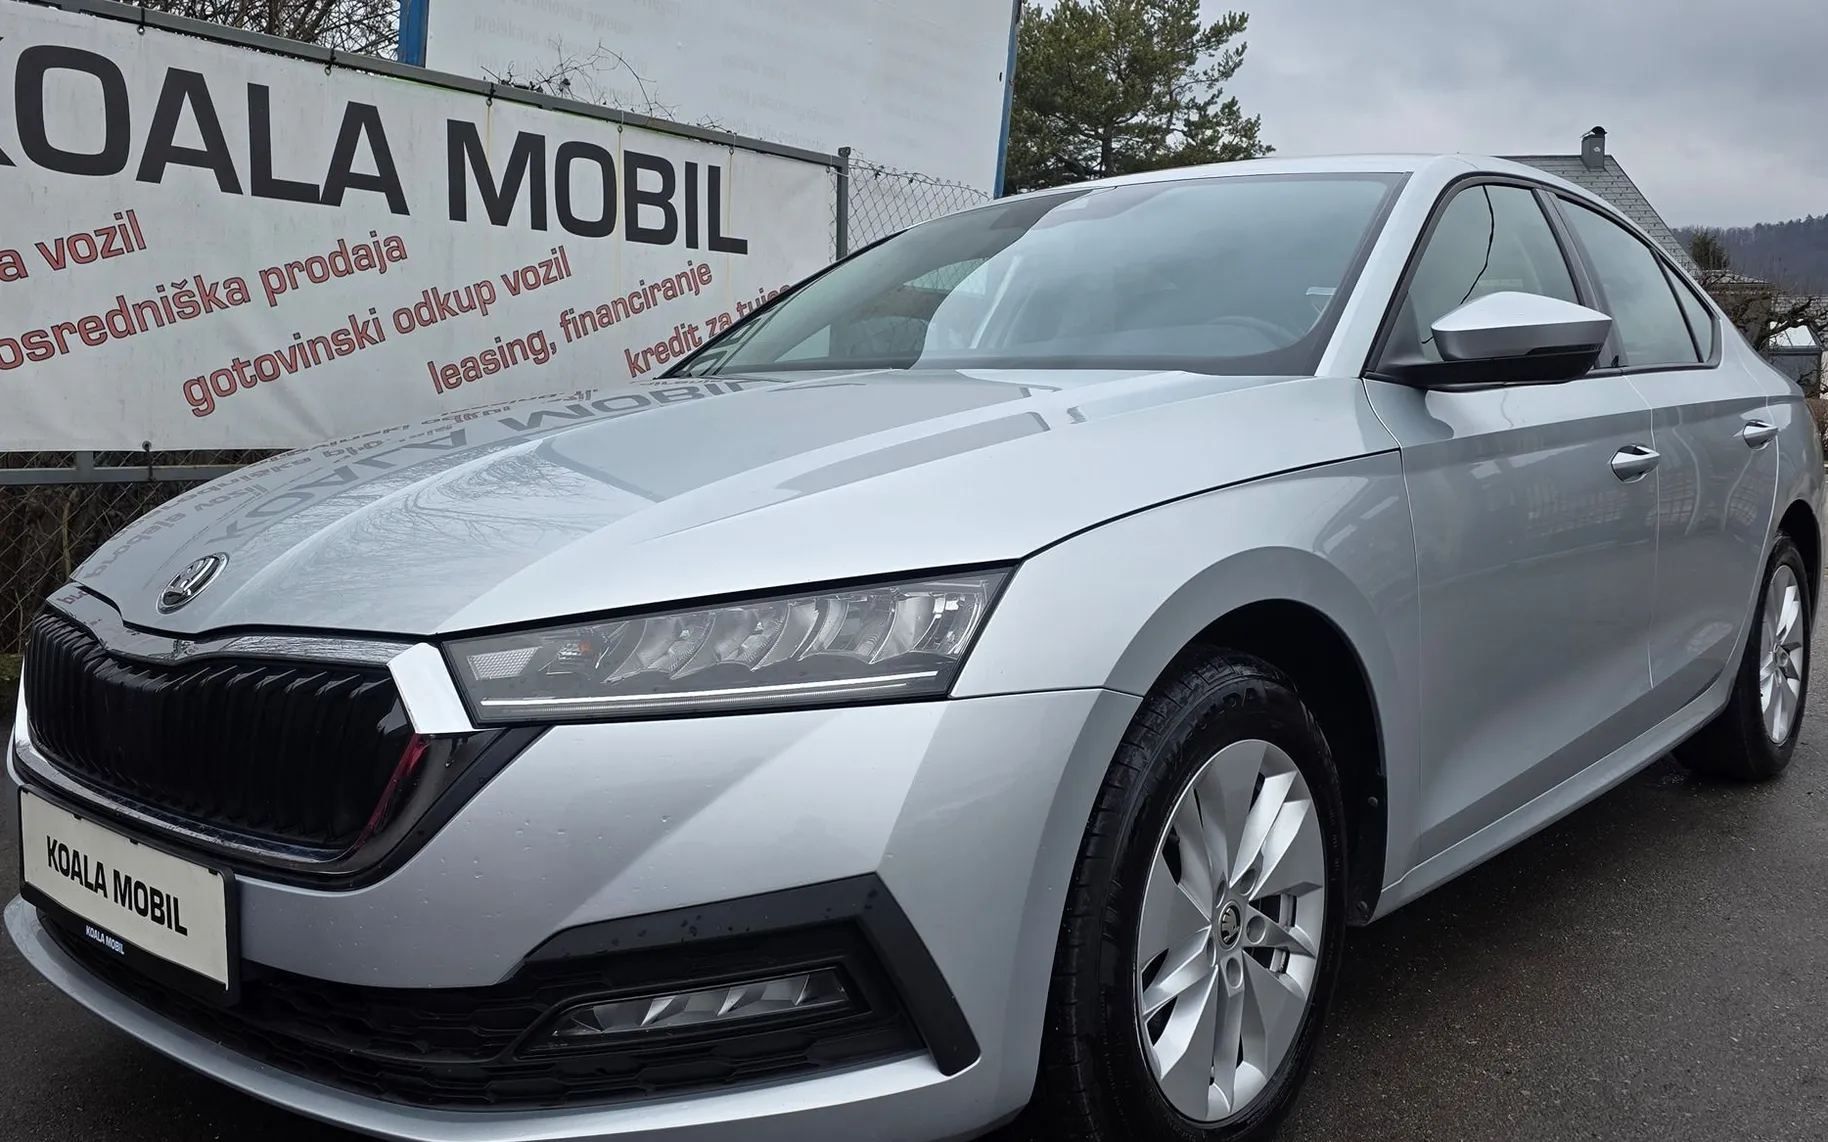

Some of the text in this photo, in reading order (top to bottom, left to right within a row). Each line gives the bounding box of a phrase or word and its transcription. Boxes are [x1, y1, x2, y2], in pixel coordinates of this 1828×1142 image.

[0, 37, 748, 255] OALA MOBIL
[34, 209, 147, 271] vozil
[259, 230, 407, 307] prodaja
[182, 307, 386, 417] gotovinski
[392, 287, 496, 335] odkup
[500, 245, 572, 296] vozil
[427, 260, 713, 394] leasing, financiranje
[624, 323, 703, 379] kredit
[46, 835, 188, 937] KOALA MOBIL
[85, 925, 125, 955] KOALA MOBIL
